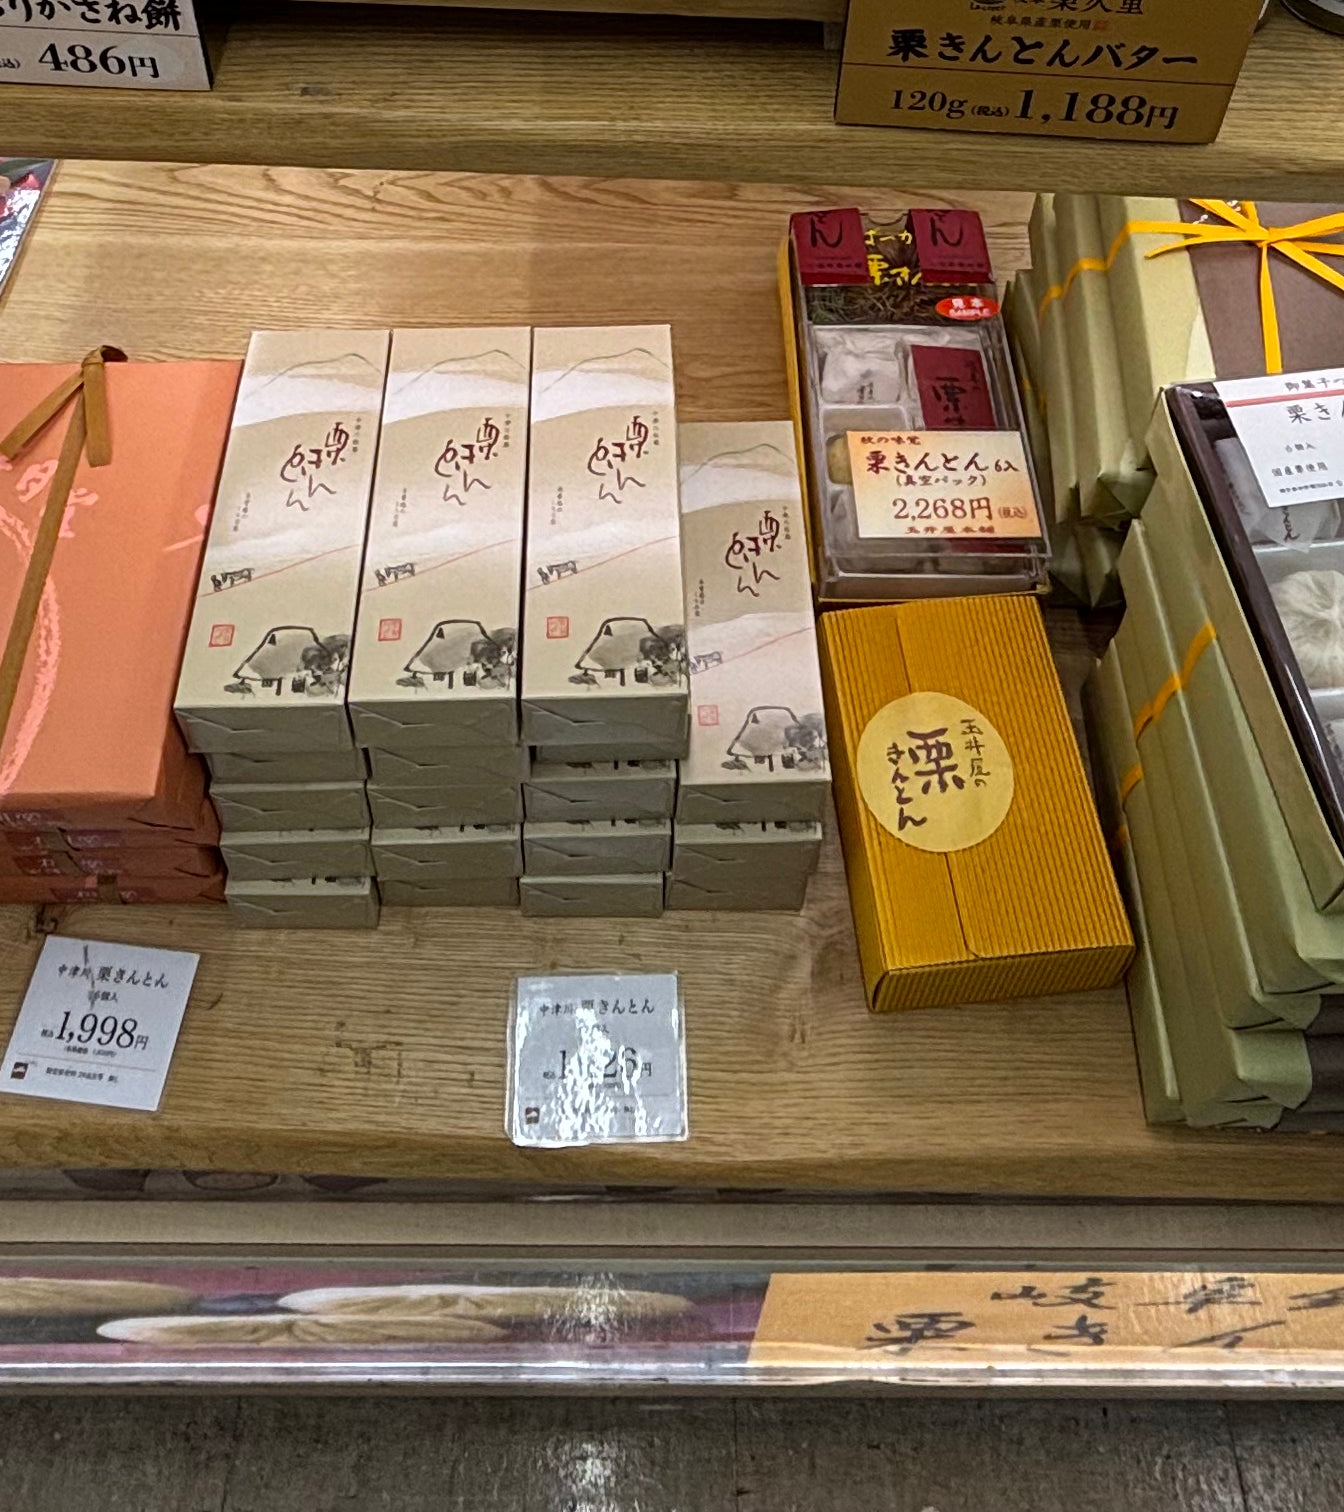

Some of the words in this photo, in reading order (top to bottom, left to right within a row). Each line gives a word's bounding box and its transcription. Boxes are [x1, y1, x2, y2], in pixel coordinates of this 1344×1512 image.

[38, 42, 160, 80] 486円
[886, 27, 1199, 71] 栗きんとんバター
[890, 88, 969, 120] 120g
[1014, 88, 1179, 130] 1,188円
[866, 451, 990, 474] 栗きんとん
[896, 474, 988, 488] (真空パック)
[892, 496, 994, 521] 2,268円
[907, 726, 966, 794] 栗
[959, 717, 993, 789] 玉井屋の
[885, 741, 929, 833] きんとん
[57, 963, 93, 979] 中津川
[95, 965, 170, 989] 栗きんとん
[55, 1010, 150, 1051] 1,998円
